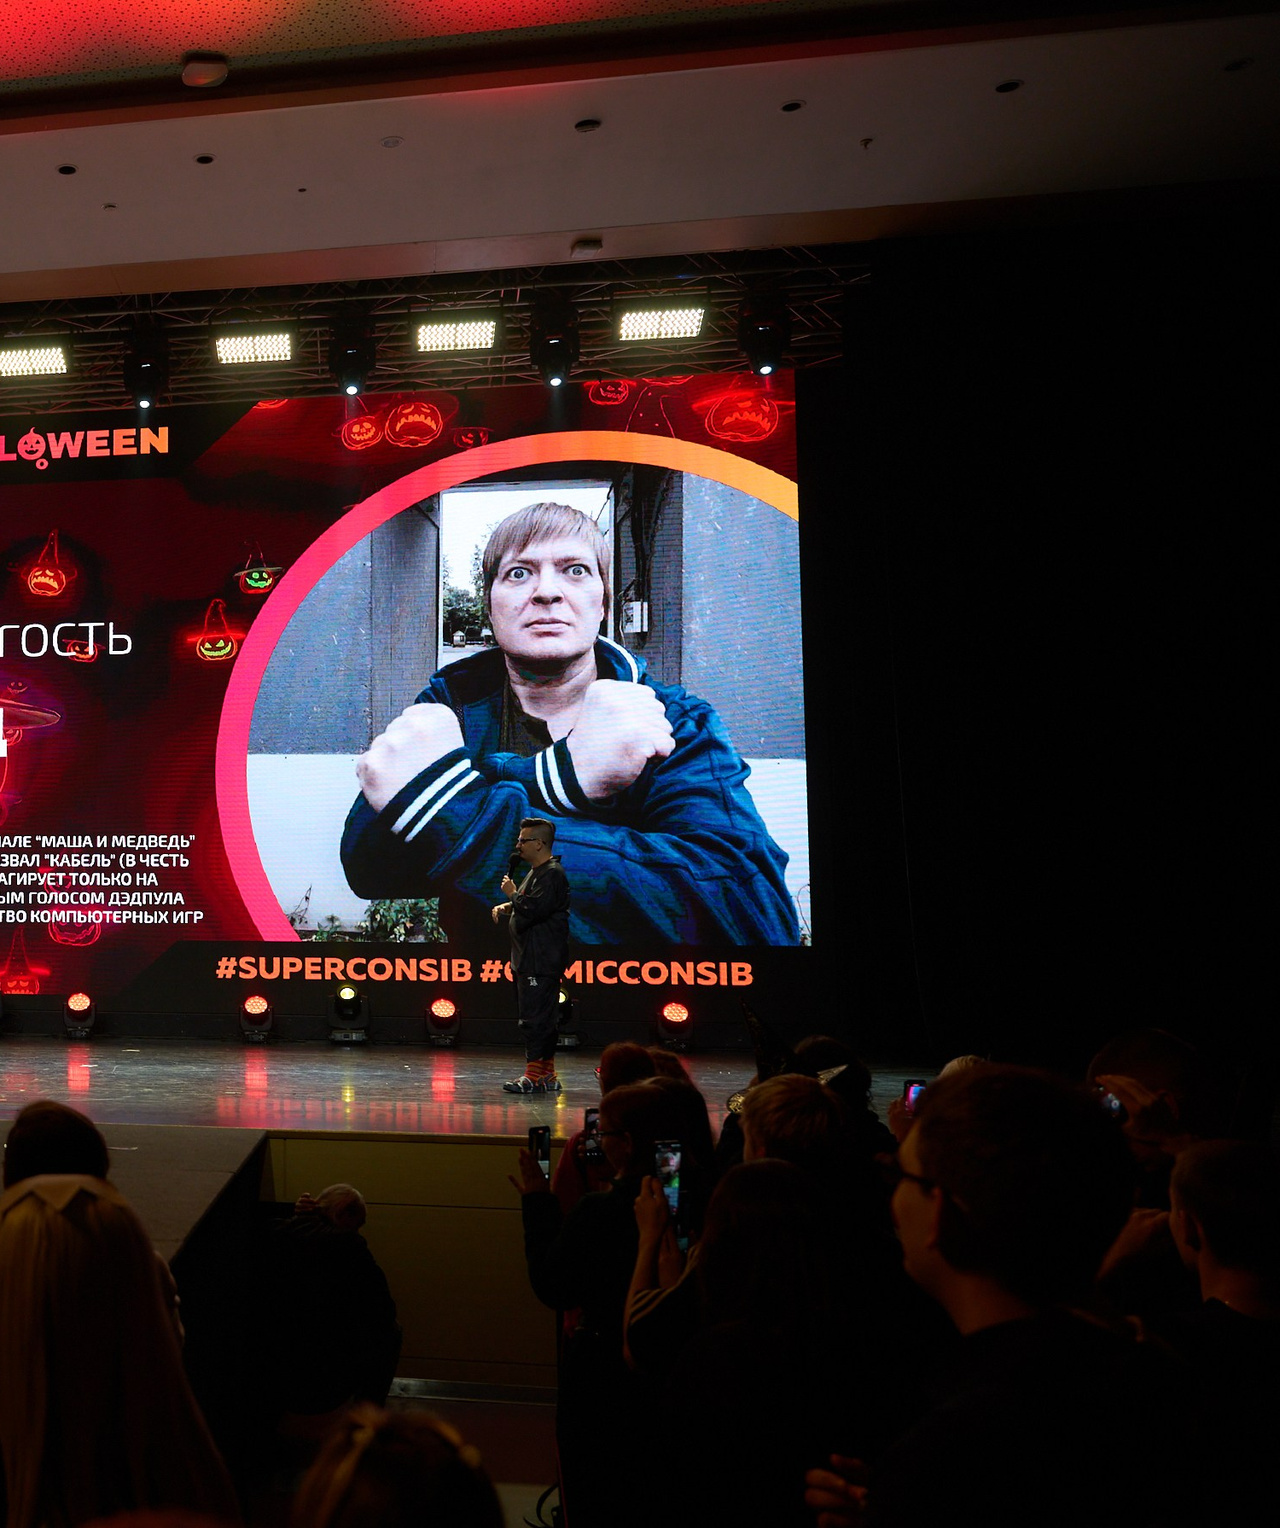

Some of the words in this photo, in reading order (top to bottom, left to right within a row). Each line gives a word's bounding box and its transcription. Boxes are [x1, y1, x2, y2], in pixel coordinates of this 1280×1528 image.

[96, 835, 107, 848] И
[119, 853, 136, 869] (В
[139, 854, 189, 868] ЧЕСТЬ
[69, 873, 132, 886] ТОЛЬКО
[135, 873, 159, 886] НА
[28, 892, 105, 905] ГОЛОСОМ
[108, 892, 185, 906] ДЭДПУЛА
[30, 910, 169, 924] КОМПЬЮТЕРНЫХ
[172, 911, 204, 924] ИГР
[216, 956, 473, 983] #SUPERCONSIB
[480, 959, 753, 986] #MICCONSIB
